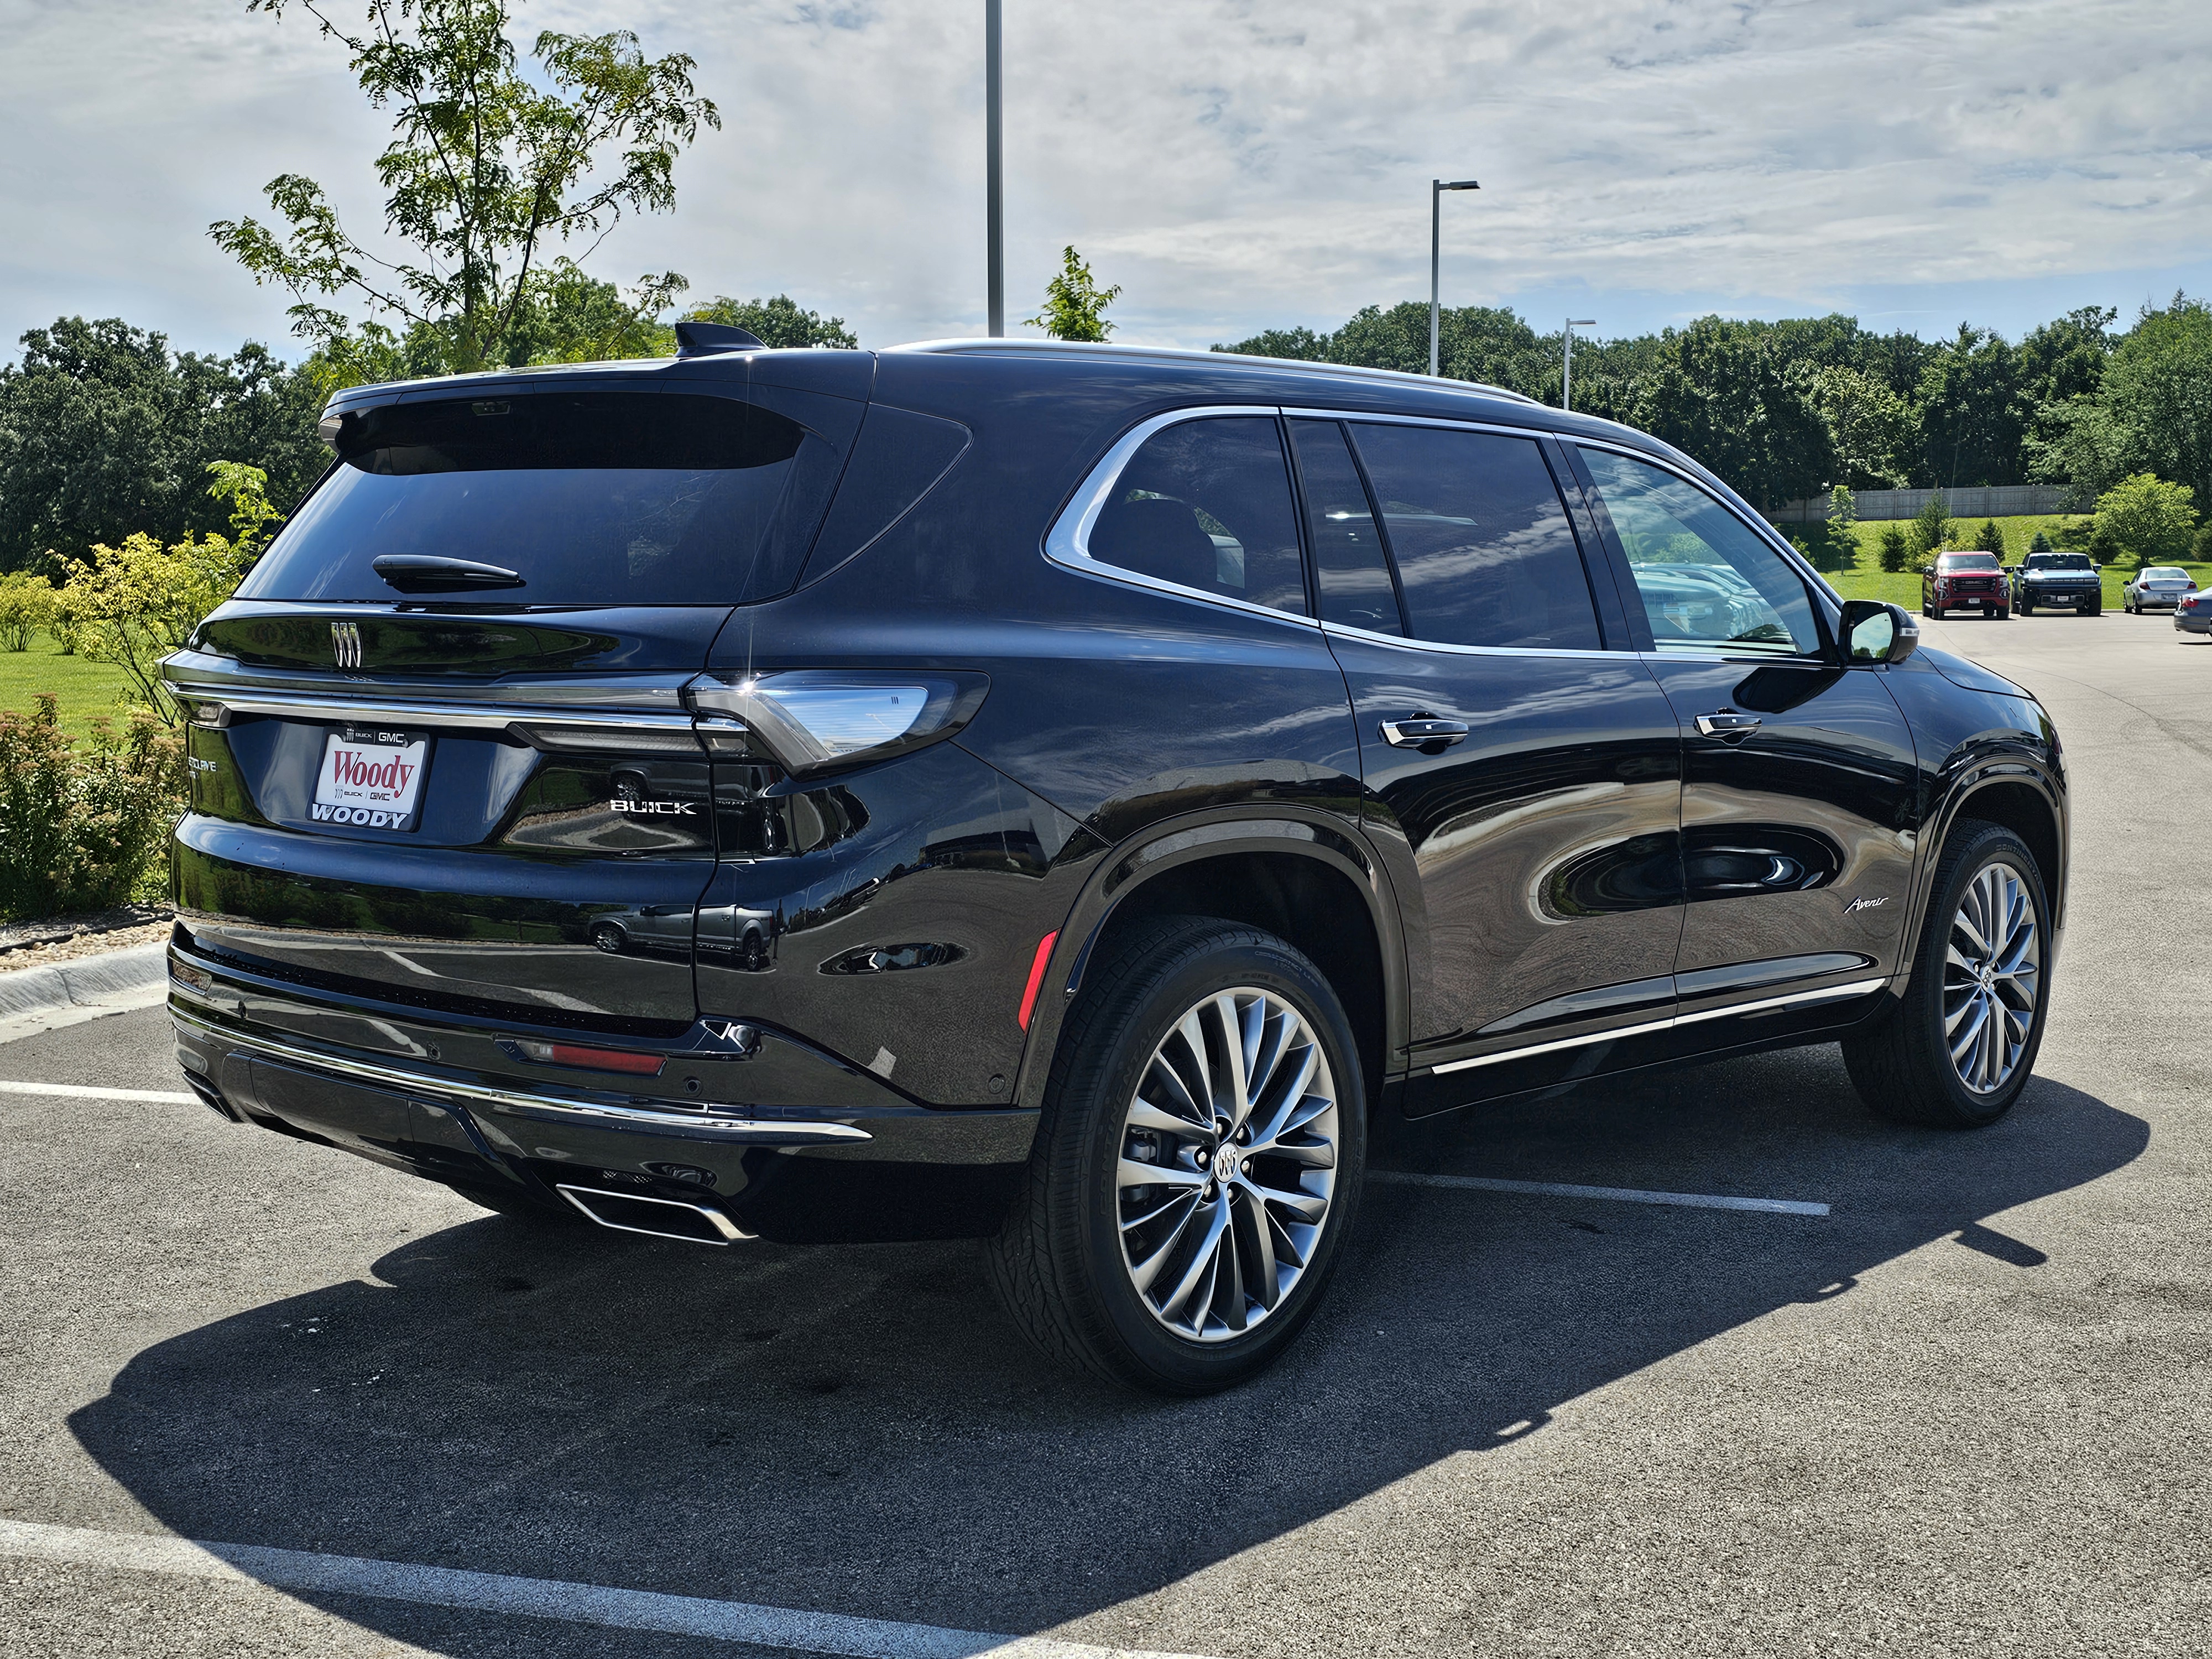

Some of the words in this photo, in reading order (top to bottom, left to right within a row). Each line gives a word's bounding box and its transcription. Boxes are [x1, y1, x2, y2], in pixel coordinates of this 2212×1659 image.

[378, 732, 405, 743] GMC
[334, 750, 415, 799] Woody
[369, 792, 390, 801] GMC
[610, 799, 697, 815] BUICK
[312, 803, 408, 829] WOODY
[1843, 895, 1889, 914] Avenir
